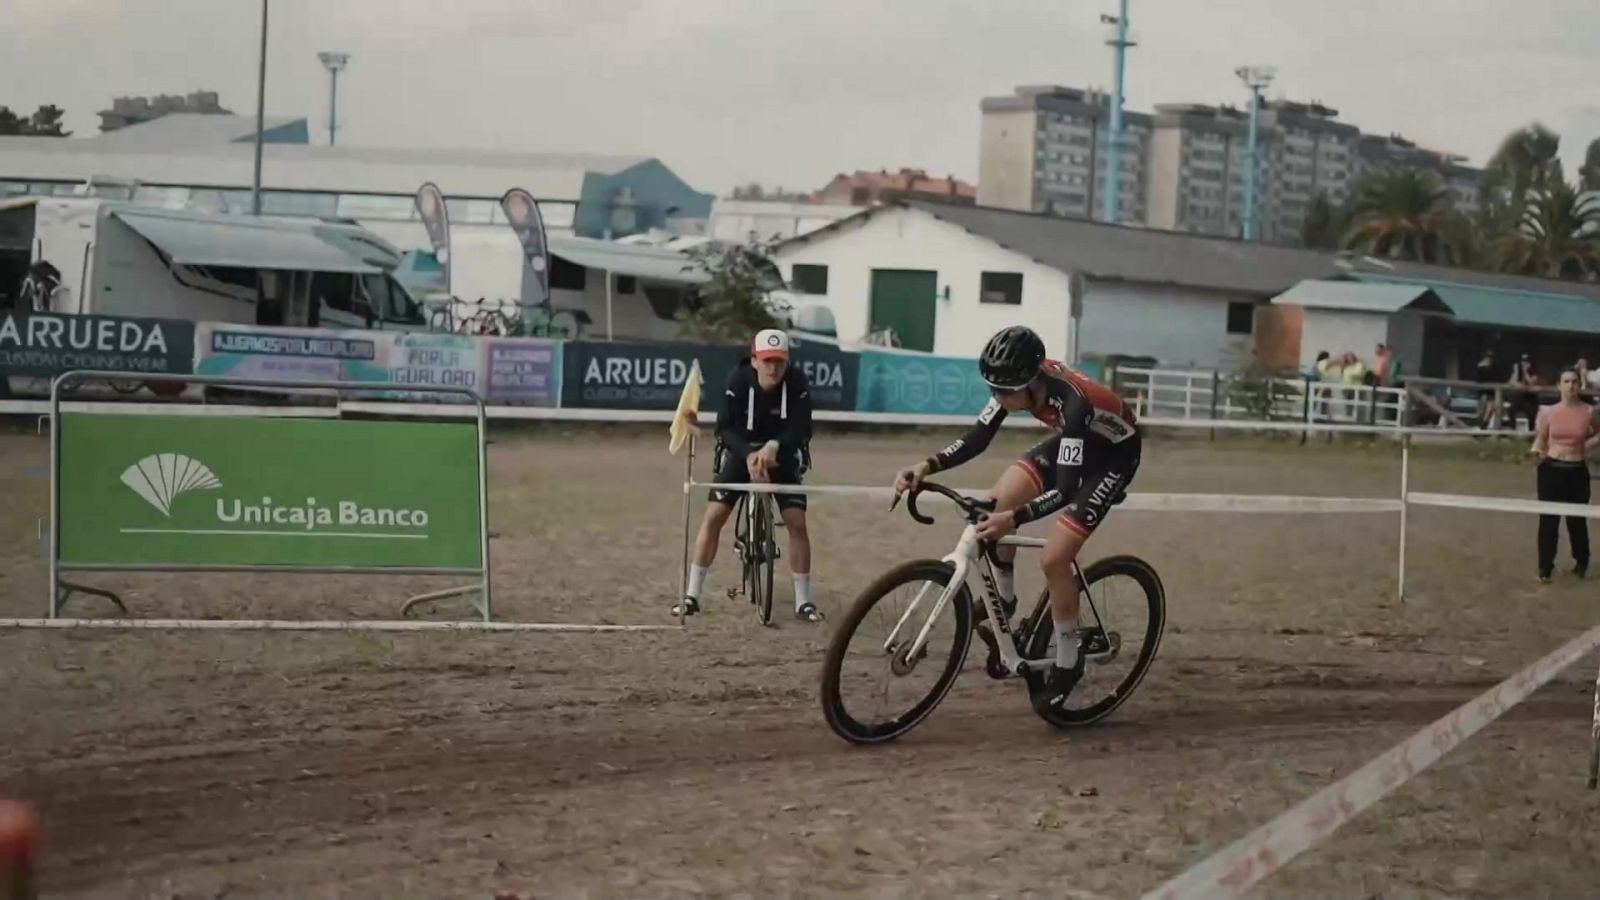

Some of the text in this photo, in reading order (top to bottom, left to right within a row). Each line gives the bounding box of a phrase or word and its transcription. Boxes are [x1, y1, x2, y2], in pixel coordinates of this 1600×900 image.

[0, 314, 168, 353] ARRUEDA
[1089, 471, 1121, 505] VITAL
[216, 496, 429, 530] Unicaja Banco
